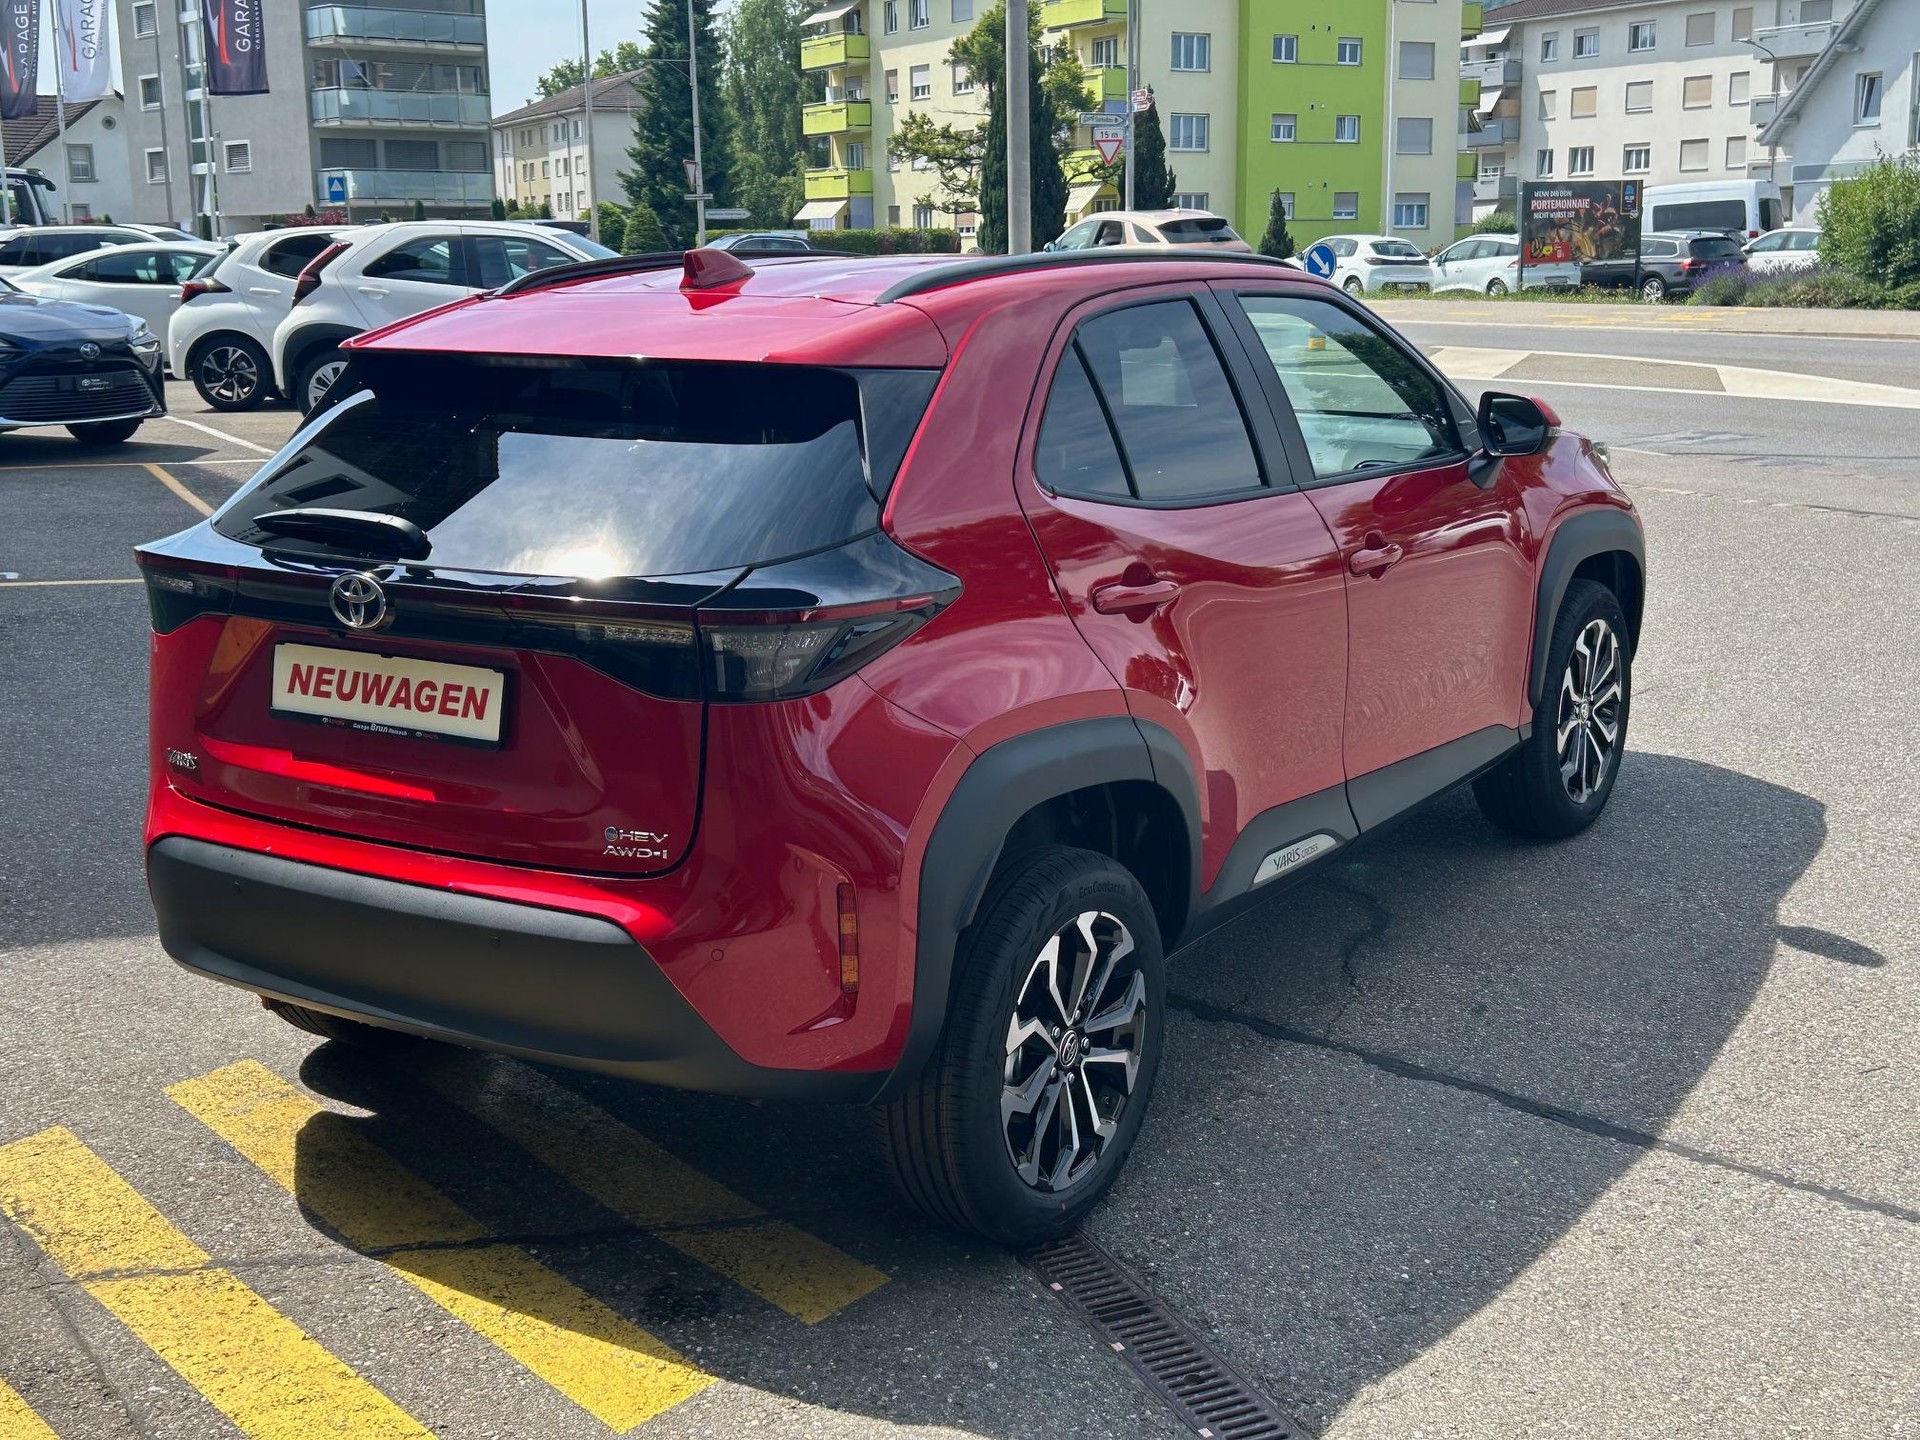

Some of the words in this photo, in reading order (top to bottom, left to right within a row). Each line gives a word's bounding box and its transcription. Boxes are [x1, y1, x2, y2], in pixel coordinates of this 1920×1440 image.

[1531, 199, 1590, 210] PORTEMONNAIE
[287, 663, 490, 721] NEUWAGEN
[619, 829, 668, 843] HEV
[1273, 848, 1301, 870] YARIS
[1301, 843, 1319, 859] CROSS
